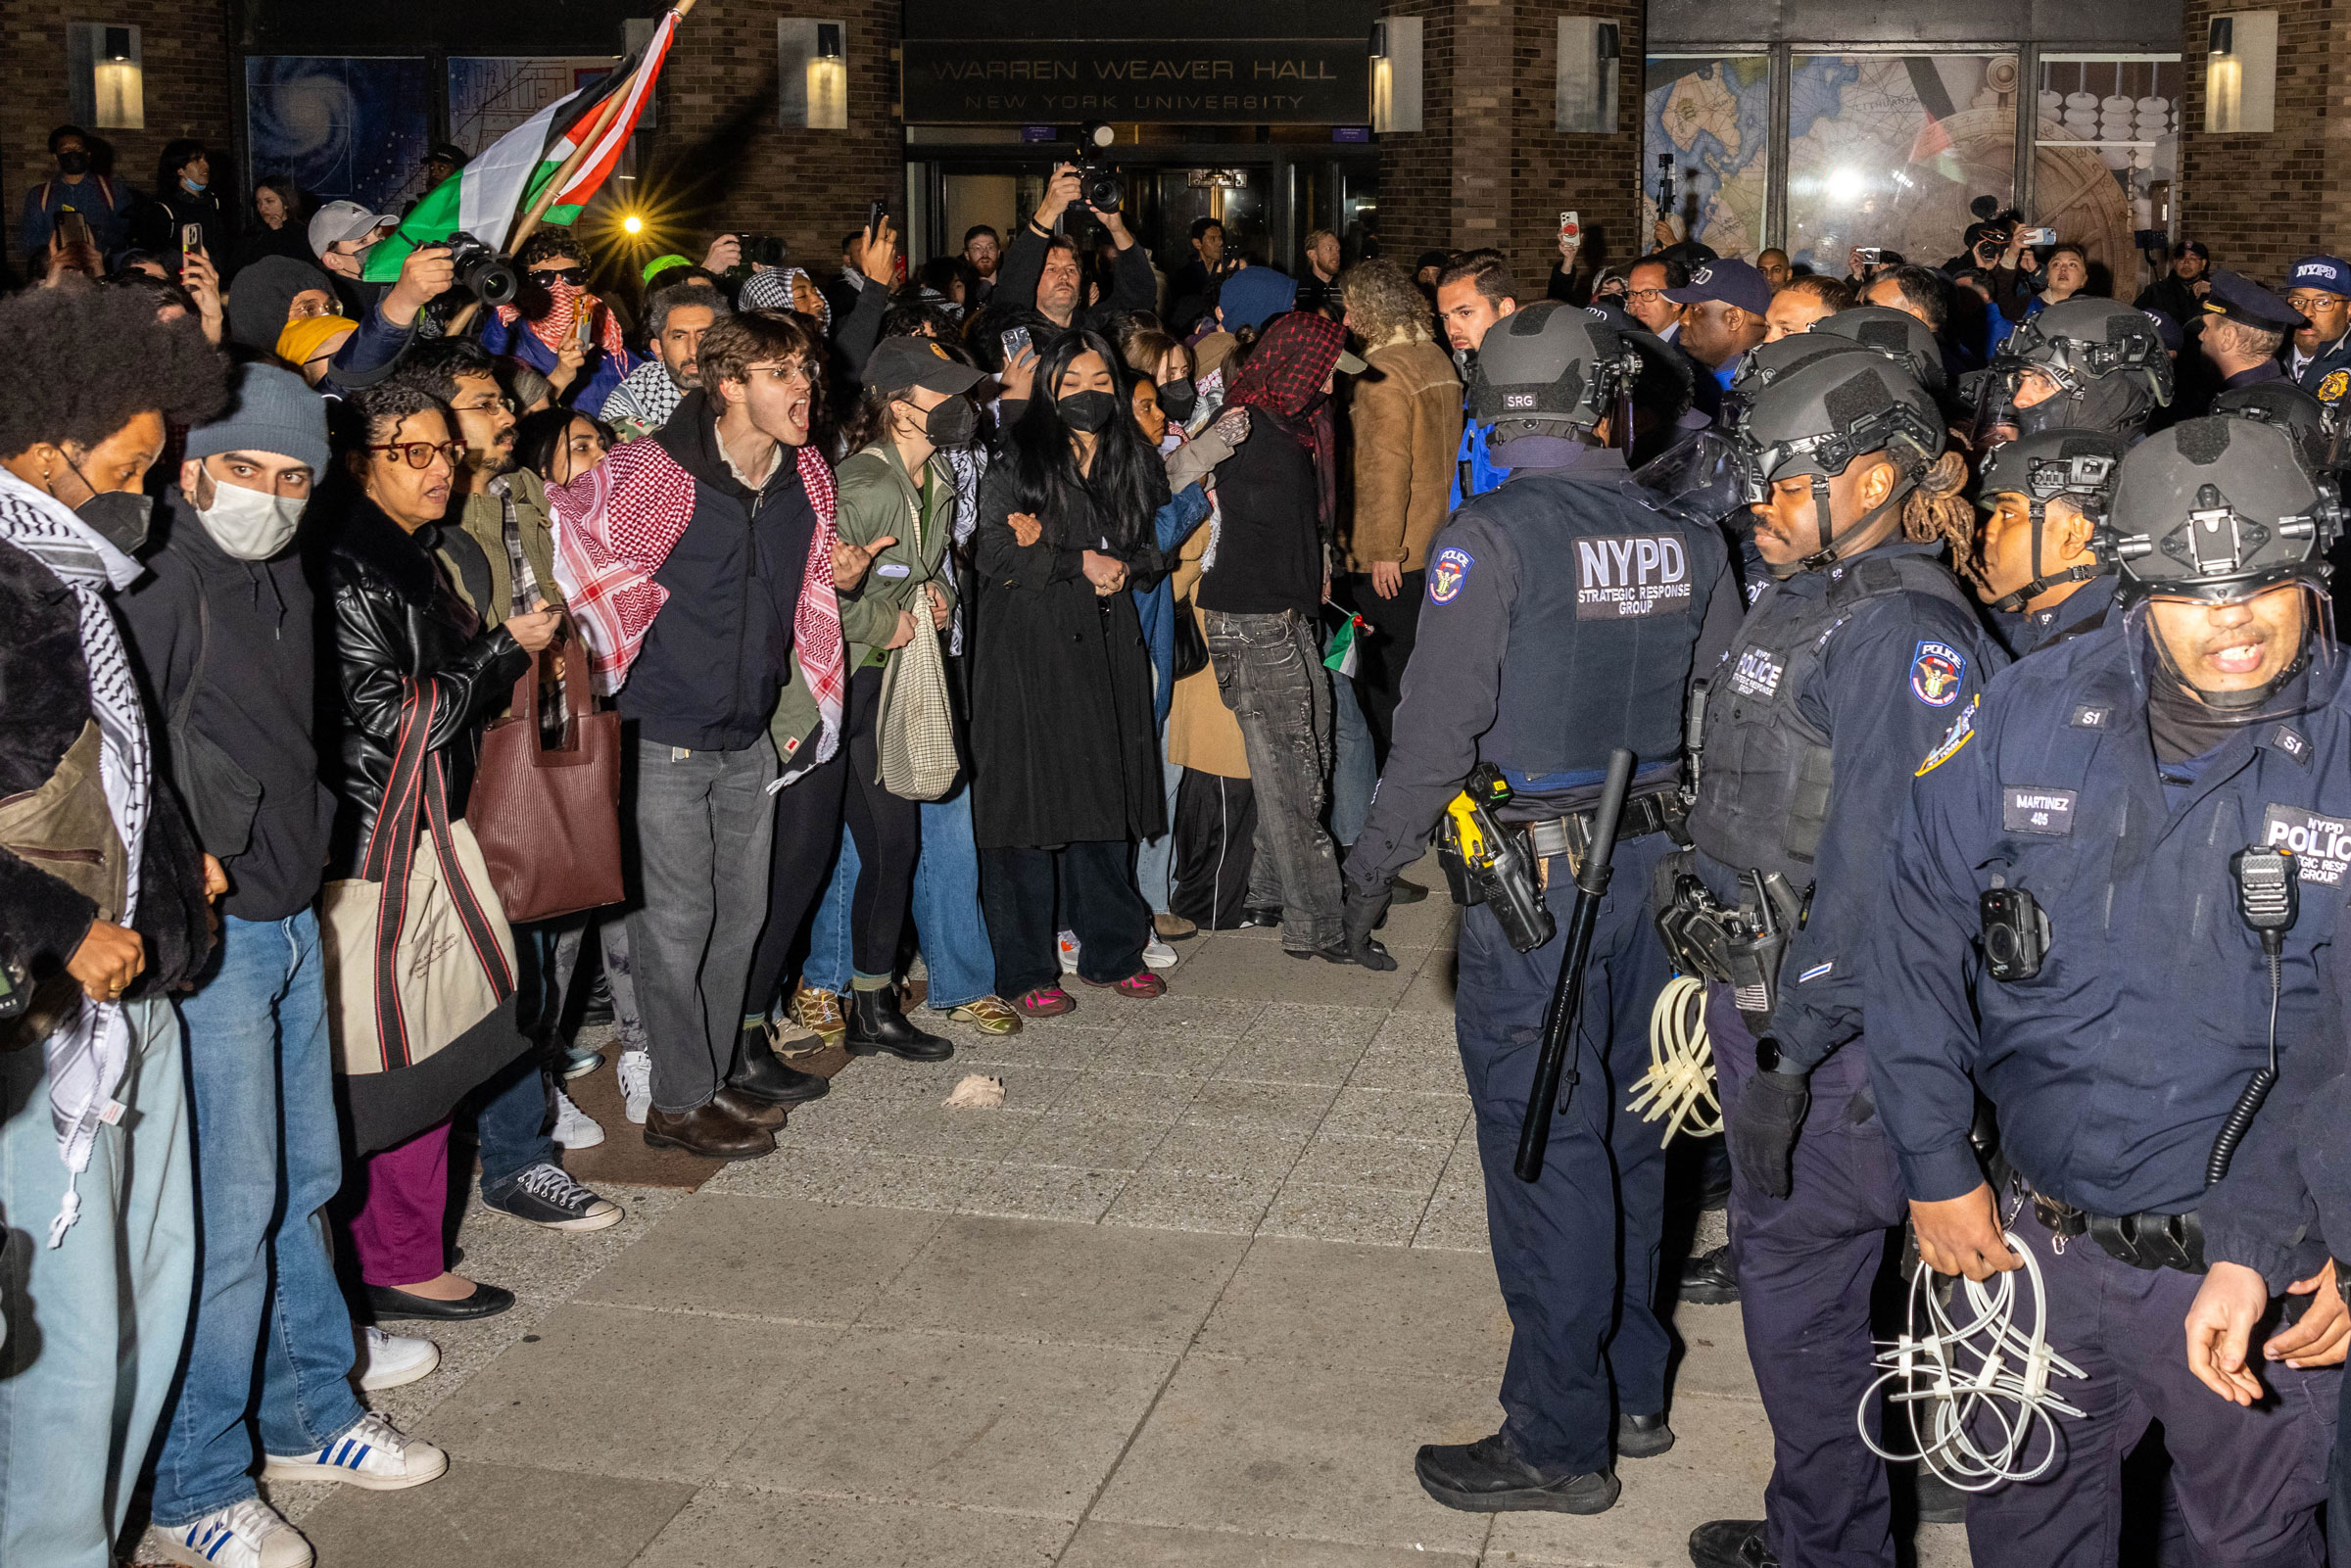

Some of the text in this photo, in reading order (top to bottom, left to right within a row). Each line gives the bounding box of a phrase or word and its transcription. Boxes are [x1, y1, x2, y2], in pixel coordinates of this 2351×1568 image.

[933, 60, 1337, 79] WARREN WEAVER HALL
[965, 94, 1306, 110] NEW YORK UNIVERSITY
[2296, 263, 2337, 280] NYPD
[1507, 395, 1534, 407] SRG
[1440, 549, 1469, 568] POLICE
[1578, 538, 1685, 588] NYPD
[1578, 584, 1691, 603] STRATEGIC RESPONSE
[1618, 600, 1654, 615] GROUP
[1922, 643, 1962, 669] POLICE
[1735, 652, 1783, 689] POLICE
[2082, 711, 2101, 725] S1
[2282, 735, 2303, 754] S1
[2016, 794, 2069, 811] MARTINEZ
[2307, 817, 2344, 834] NYPD
[2299, 868, 2339, 882] GROUP
